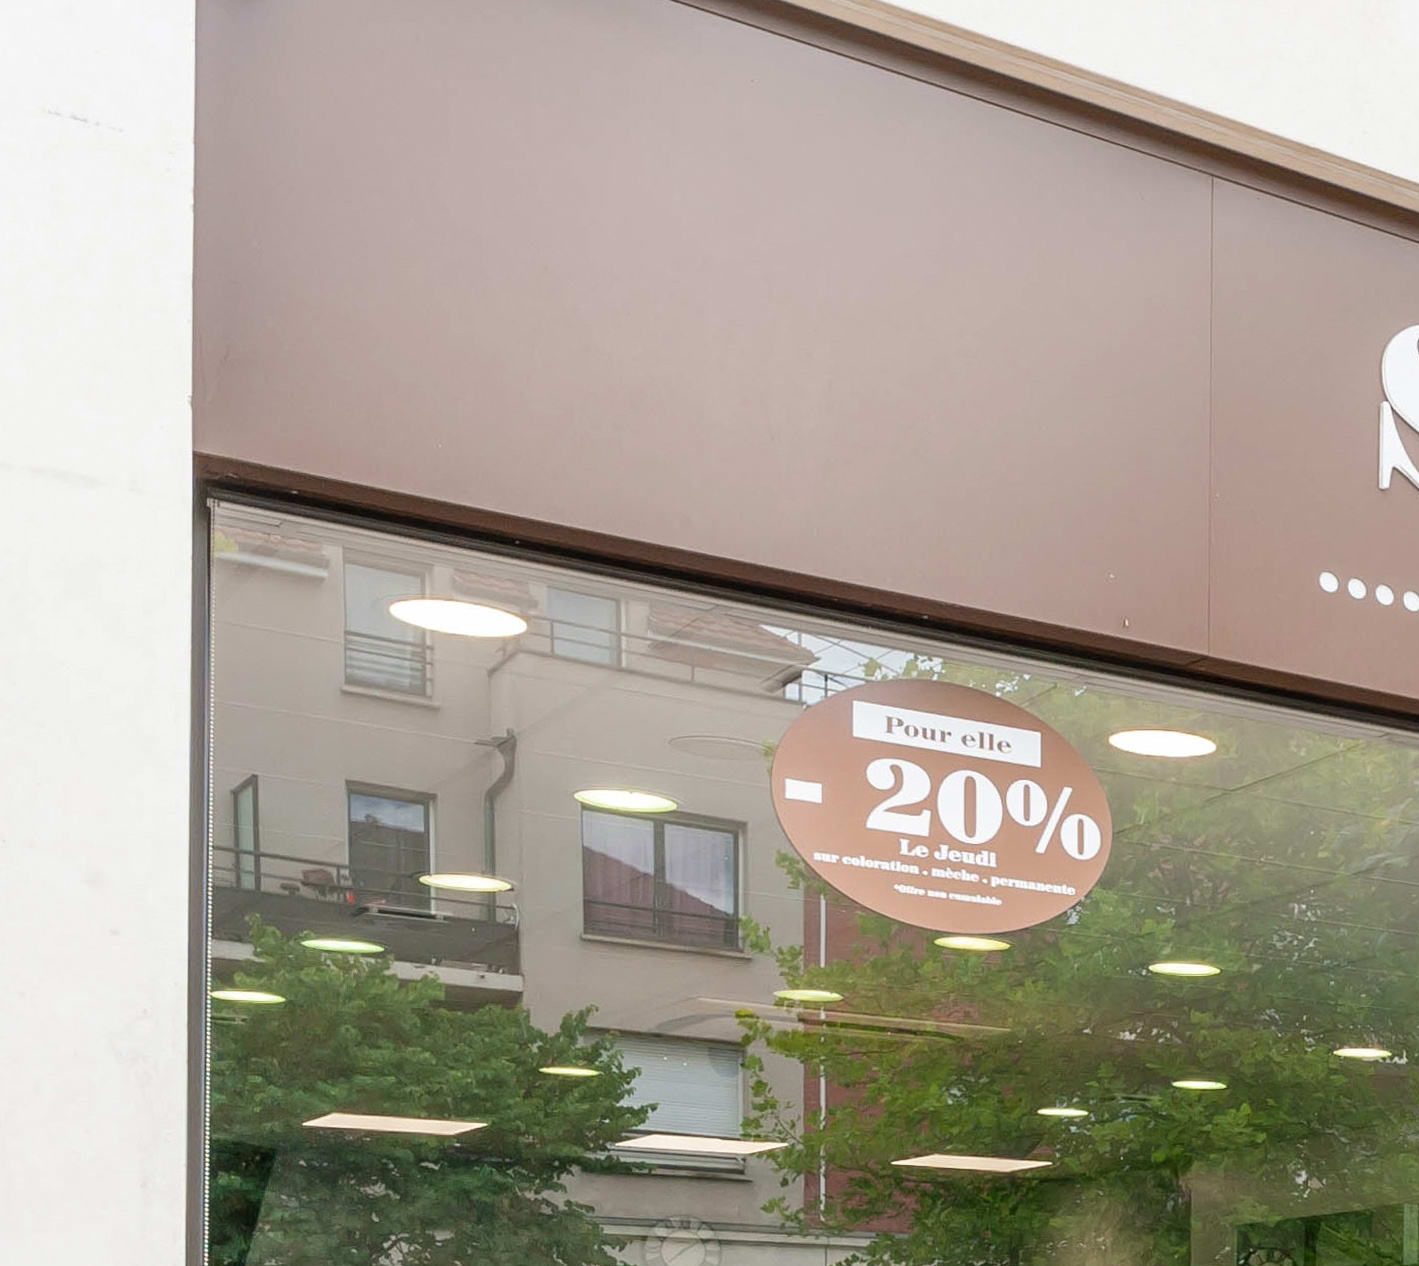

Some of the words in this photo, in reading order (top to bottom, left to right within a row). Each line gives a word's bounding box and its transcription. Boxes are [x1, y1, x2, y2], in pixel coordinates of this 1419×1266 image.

[885, 715, 952, 742] Pour
[961, 731, 1012, 754] elle
[899, 838, 928, 860] Le
[934, 844, 997, 868] Jeudi
[842, 855, 920, 874] coloration
[931, 867, 979, 883] mèche
[990, 875, 1076, 896] permanente
